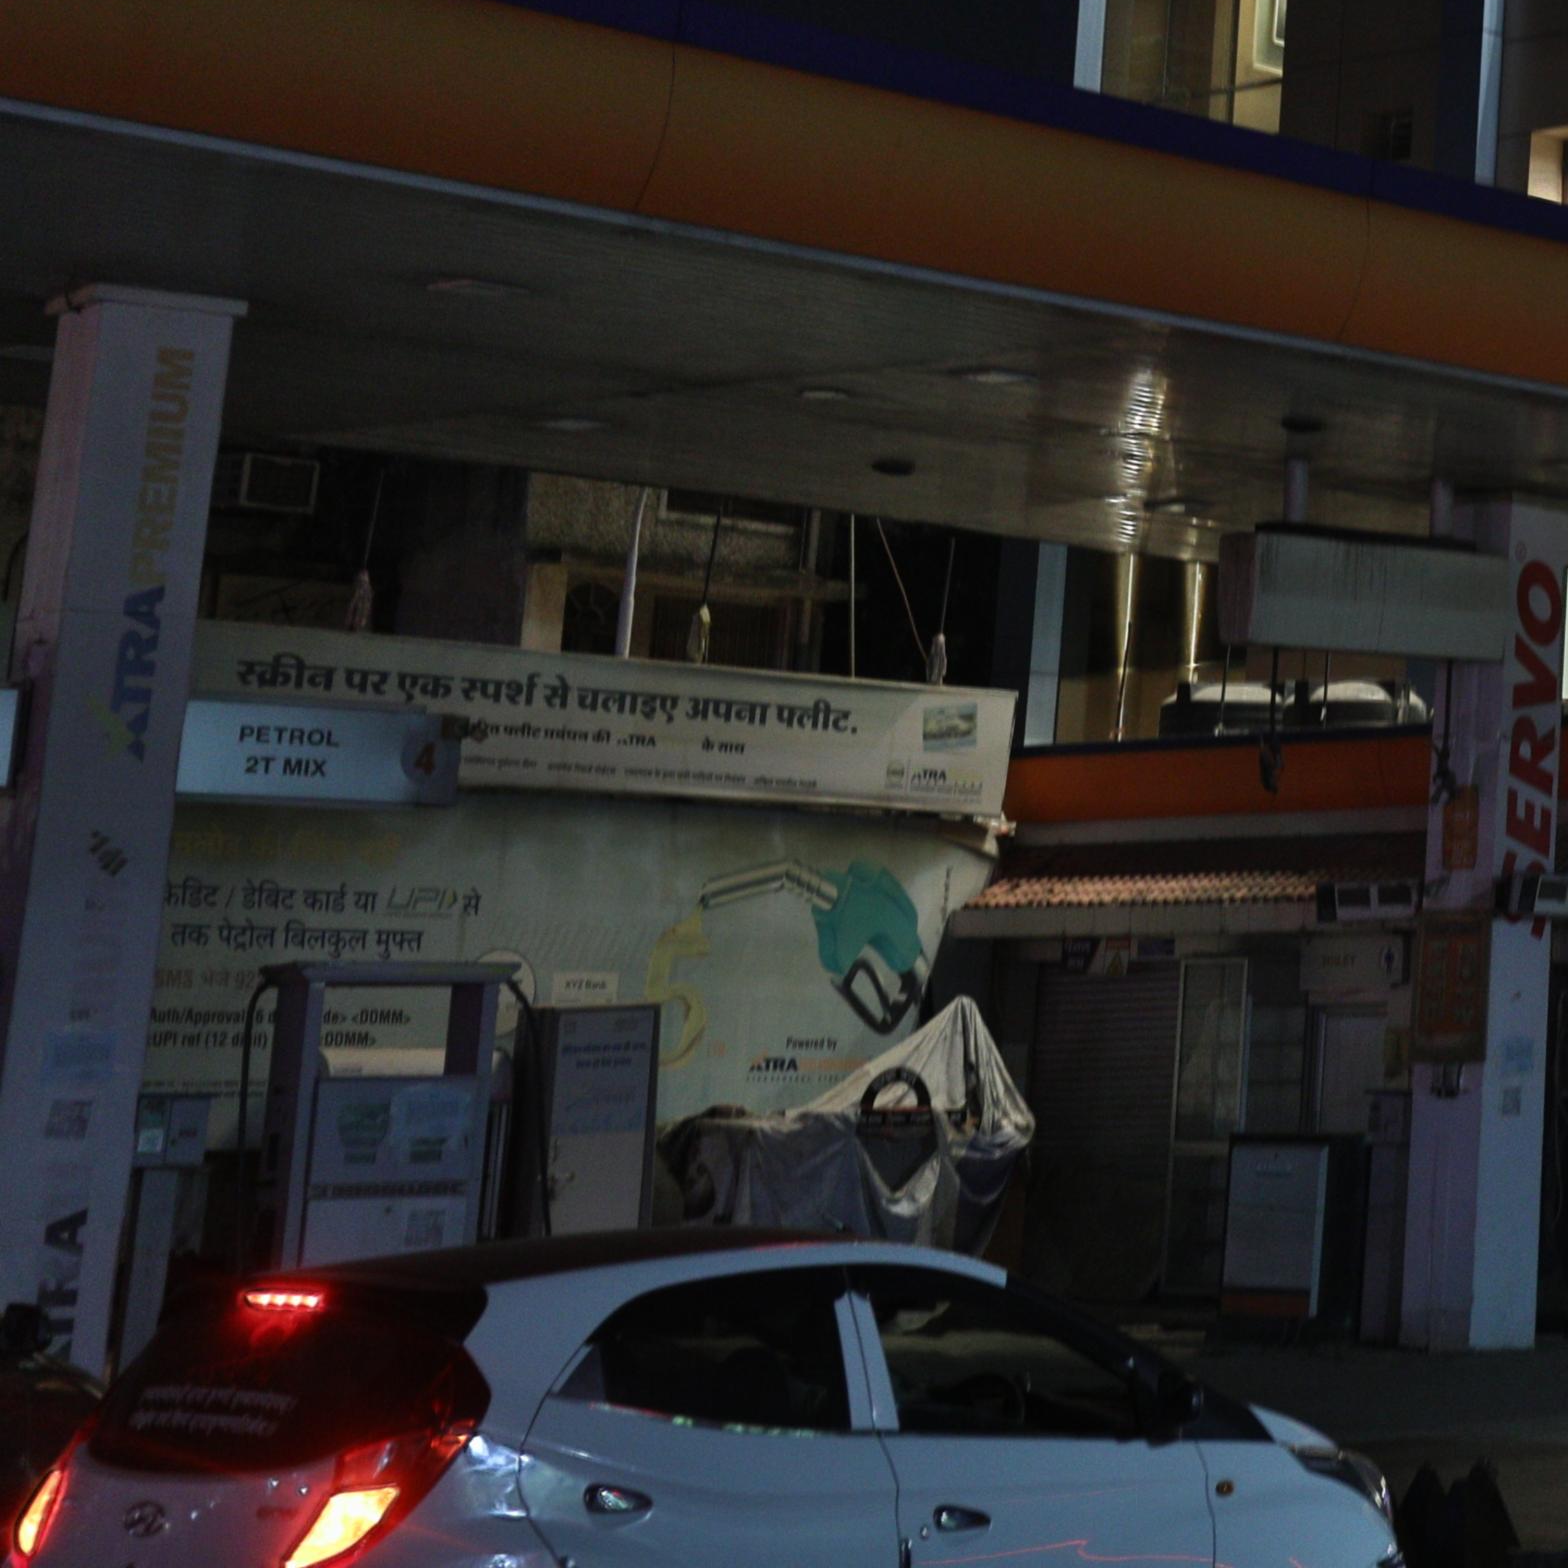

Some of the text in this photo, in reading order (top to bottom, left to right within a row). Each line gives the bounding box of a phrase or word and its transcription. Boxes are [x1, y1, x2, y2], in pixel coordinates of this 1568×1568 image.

[236, 652, 337, 693] स्क्रीन
[344, 666, 392, 697] पर
[398, 669, 455, 704] एक
[461, 671, 541, 708] स्पर्श
[544, 673, 574, 711] से
[577, 682, 680, 724] चलाइए
[685, 696, 770, 727] अपना
[238, 724, 340, 748] PETROL
[244, 757, 328, 777] 2T MIX
[413, 741, 438, 776] 4
[241, 878, 296, 909] डेबिट
[303, 882, 348, 913] कार्ड
[354, 891, 379, 913] या
[462, 886, 482, 916] से
[170, 916, 425, 960] तक पेट्रोल बिलकुल मुफ्त
[231, 1031, 268, 1050] diit)
[828, 1035, 838, 1051] by
